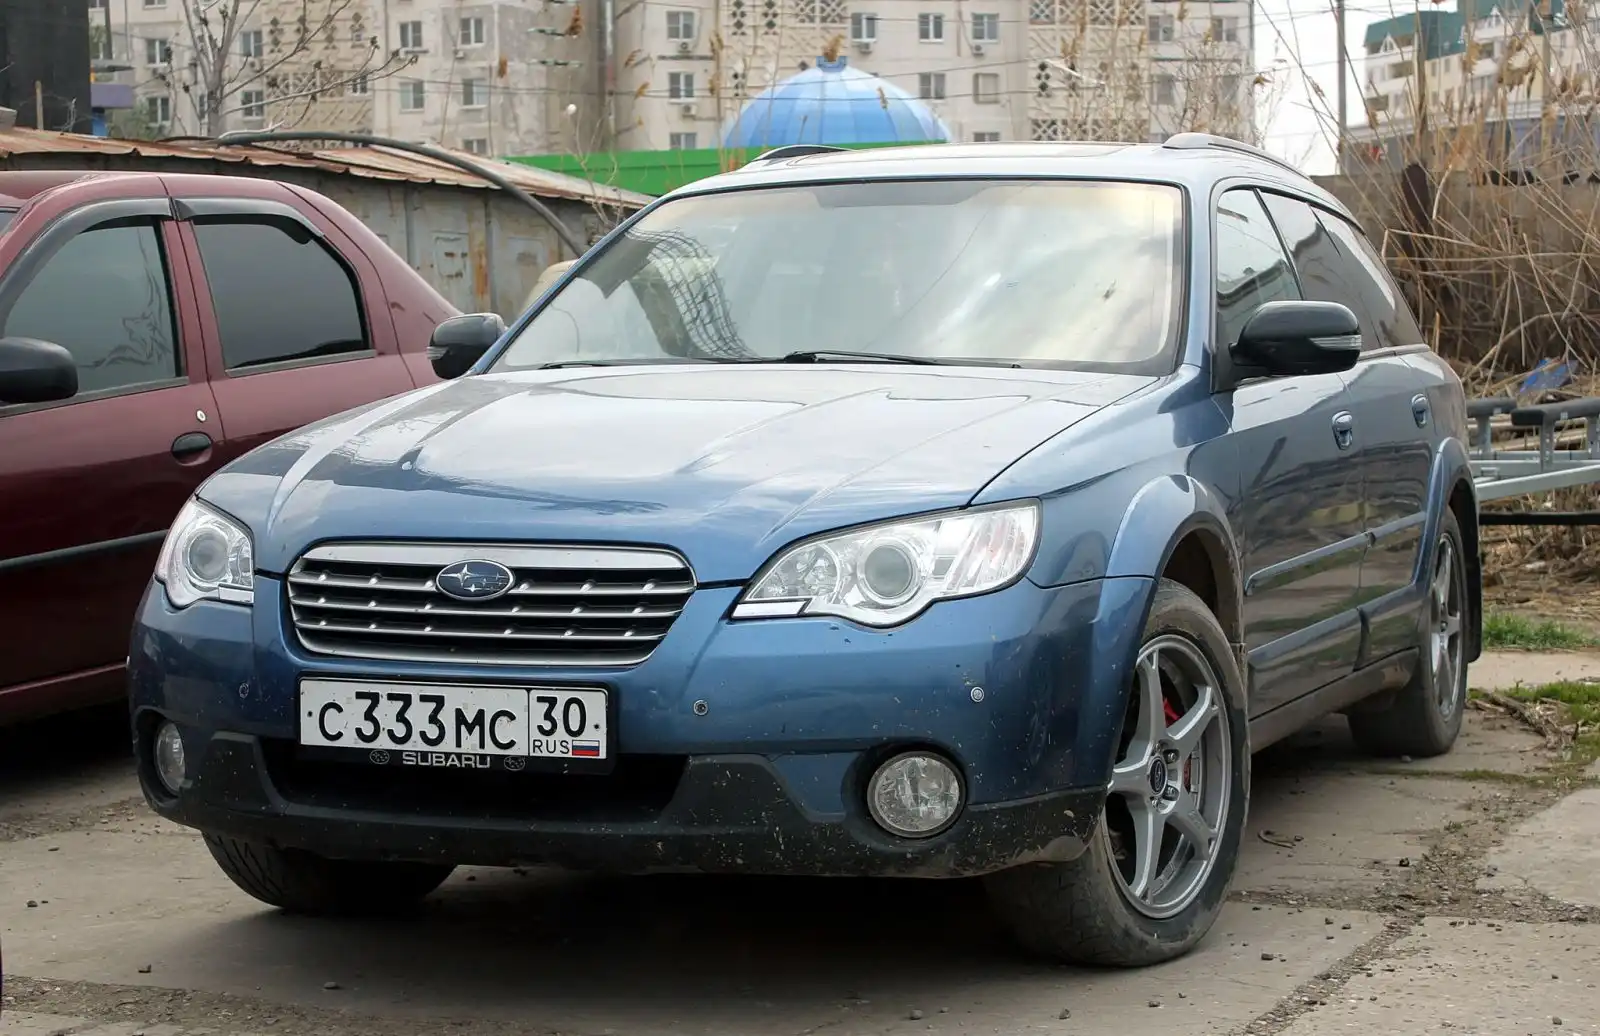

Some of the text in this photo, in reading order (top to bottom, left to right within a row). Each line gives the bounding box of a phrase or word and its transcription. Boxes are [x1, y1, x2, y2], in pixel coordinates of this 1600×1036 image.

[536, 695, 587, 738] 30
[532, 739, 570, 755] RUS
[402, 751, 491, 768] SUBARU
